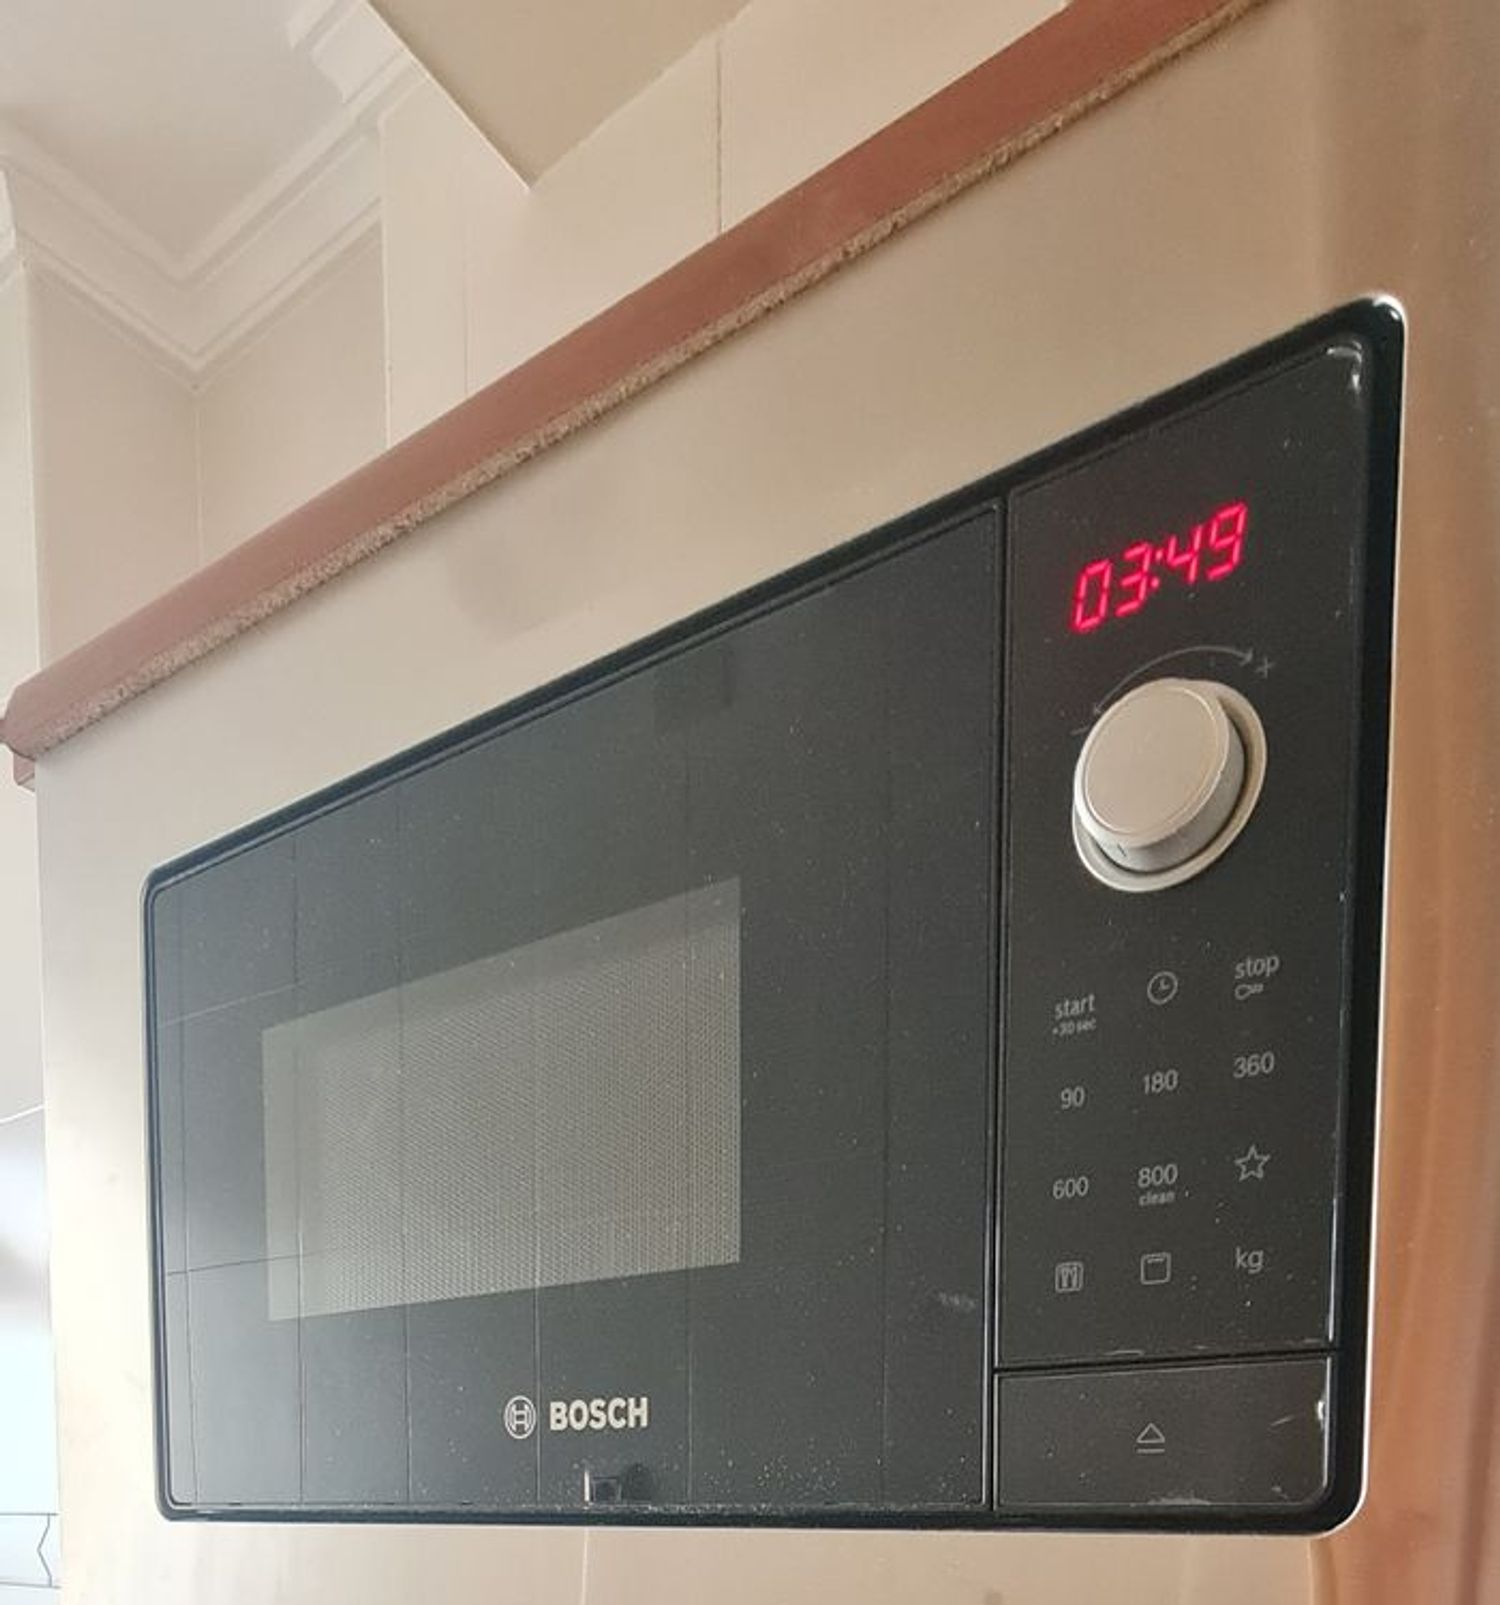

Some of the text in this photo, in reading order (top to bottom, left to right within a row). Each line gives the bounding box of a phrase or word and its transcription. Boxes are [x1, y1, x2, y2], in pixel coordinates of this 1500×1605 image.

[1072, 501, 1248, 632] 03:49
[1234, 955, 1280, 980] stop
[1054, 994, 1095, 1020] start
[1076, 1018, 1097, 1032] sec
[1233, 1051, 1275, 1079] 360
[1143, 1069, 1178, 1094] 180
[1060, 1086, 1085, 1110] 90
[1053, 1176, 1089, 1200] 600
[1137, 1163, 1178, 1189] 800
[1139, 1191, 1176, 1206] clean
[1235, 1246, 1264, 1274] kg
[549, 1397, 649, 1432] BOSCH
